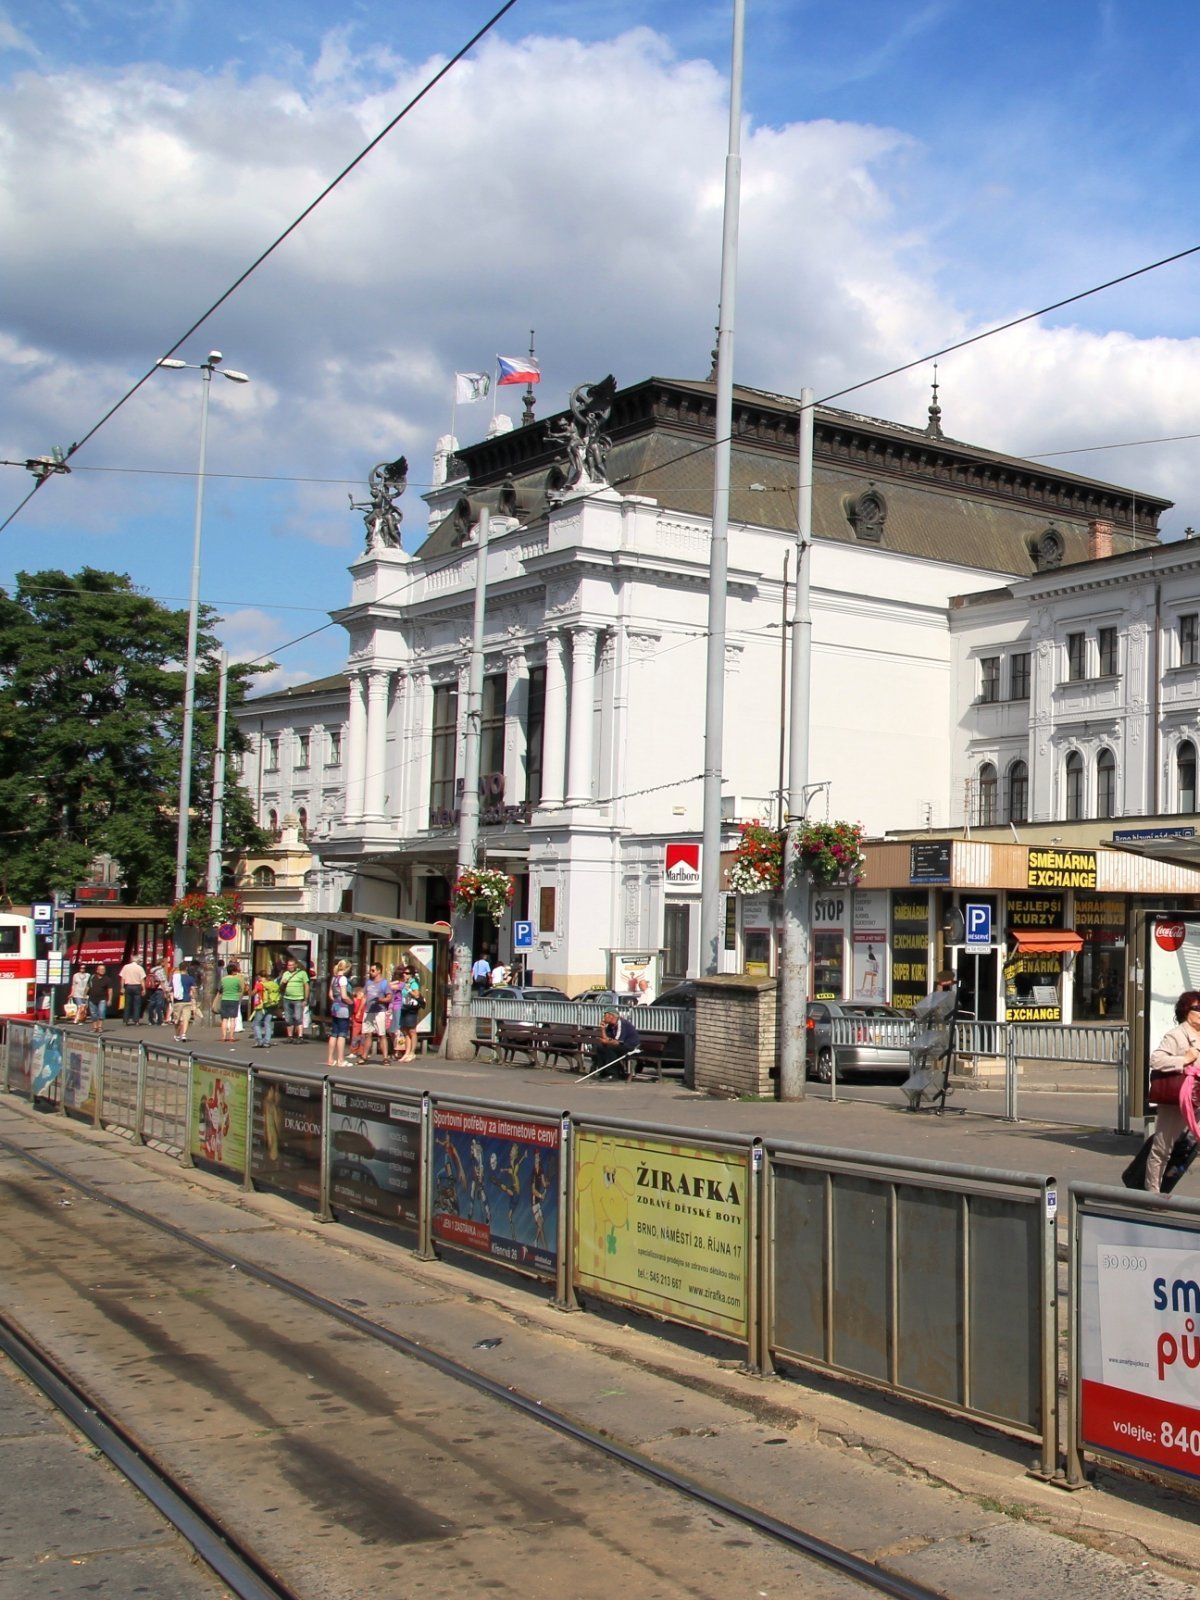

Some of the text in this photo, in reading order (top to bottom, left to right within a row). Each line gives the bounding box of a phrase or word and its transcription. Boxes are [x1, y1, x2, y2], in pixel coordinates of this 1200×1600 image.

[1029, 850, 1096, 870] SMĚNÁRNA
[662, 867, 699, 880] Marlboro
[1028, 871, 1096, 888] EXCHANGE
[814, 899, 843, 921] STOP
[1007, 900, 1061, 912] NEJLEPŠÍ
[972, 909, 986, 932] P
[1013, 914, 1055, 925] KURZY
[517, 924, 530, 940] P
[1006, 1008, 1060, 1021] EXCHANGE
[285, 1118, 320, 1135] DRAGOON
[433, 1109, 558, 1147] Sportovní potřeby za internetové ceny!
[637, 1161, 740, 1206] ŽIRAFKA
[637, 1195, 742, 1225] ZDRAVÉ DĚTSKÉ BOTY
[637, 1221, 742, 1258] BRNO, NÁMĚSTÍ 28. ŘÍJNA 17
[1103, 1254, 1147, 1272] 50 000
[649, 1271, 659, 1284] 545
[660, 1274, 671, 1287] 213
[688, 1284, 741, 1308] www.zirafka.com
[1113, 1420, 1156, 1443] volejte:
